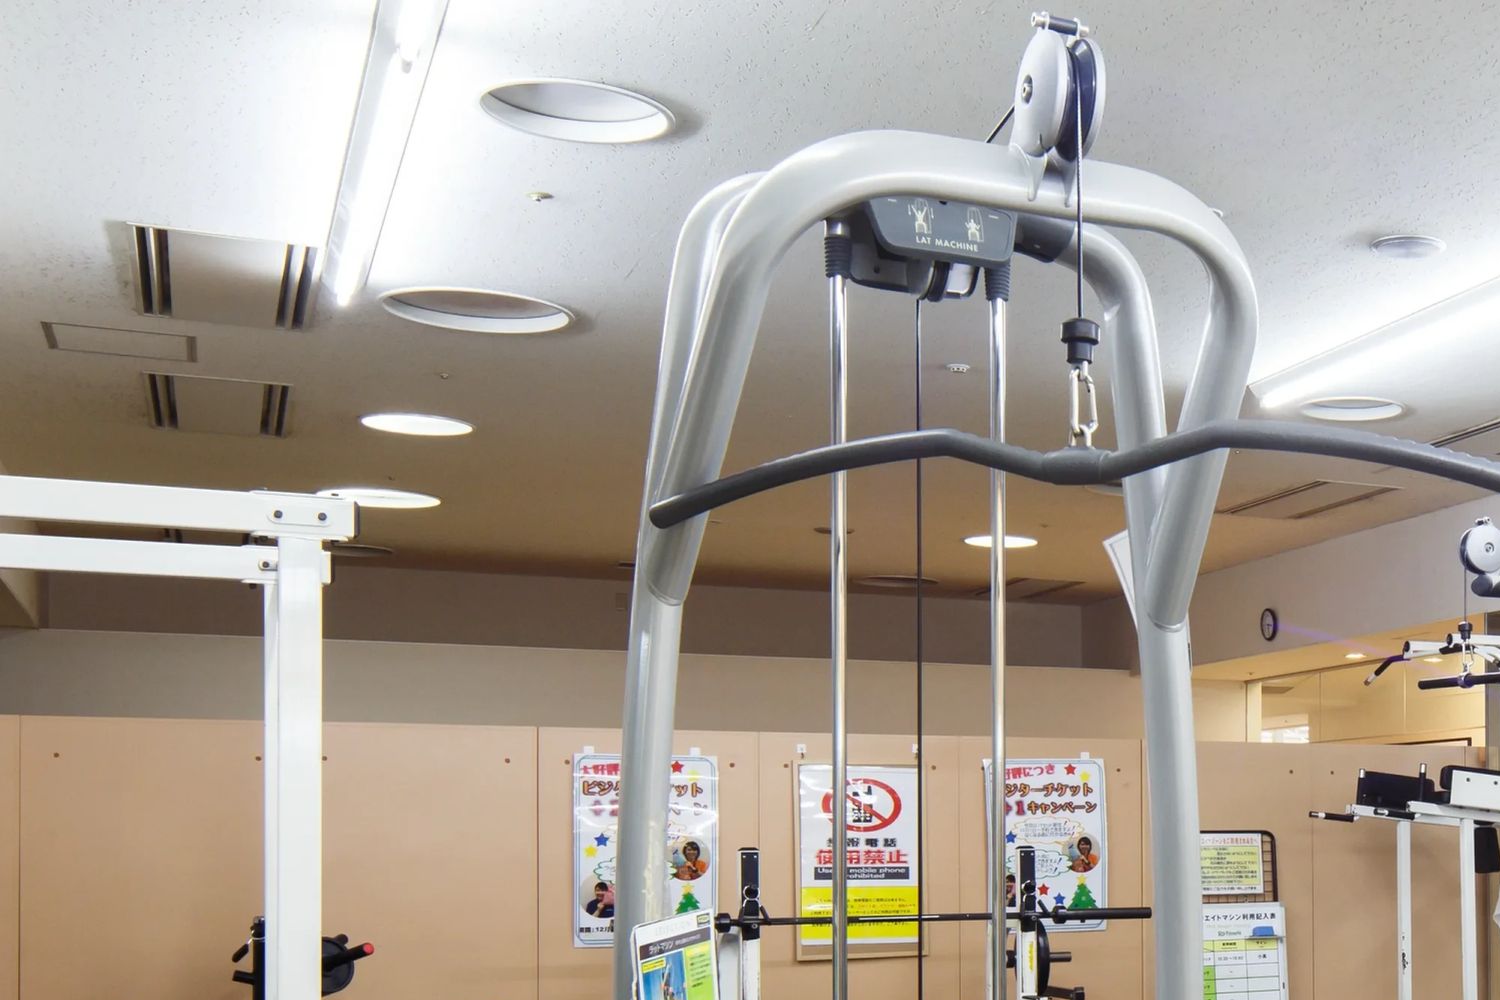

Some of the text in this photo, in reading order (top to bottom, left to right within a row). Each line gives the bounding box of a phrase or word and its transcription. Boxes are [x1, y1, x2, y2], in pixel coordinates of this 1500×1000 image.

[915, 235, 979, 252] LAT MACHINE
[1005, 763, 1055, 780] 評につき
[1005, 783, 1093, 798] ジターチケット
[827, 838, 897, 848] 帯電話
[879, 867, 906, 875] phone
